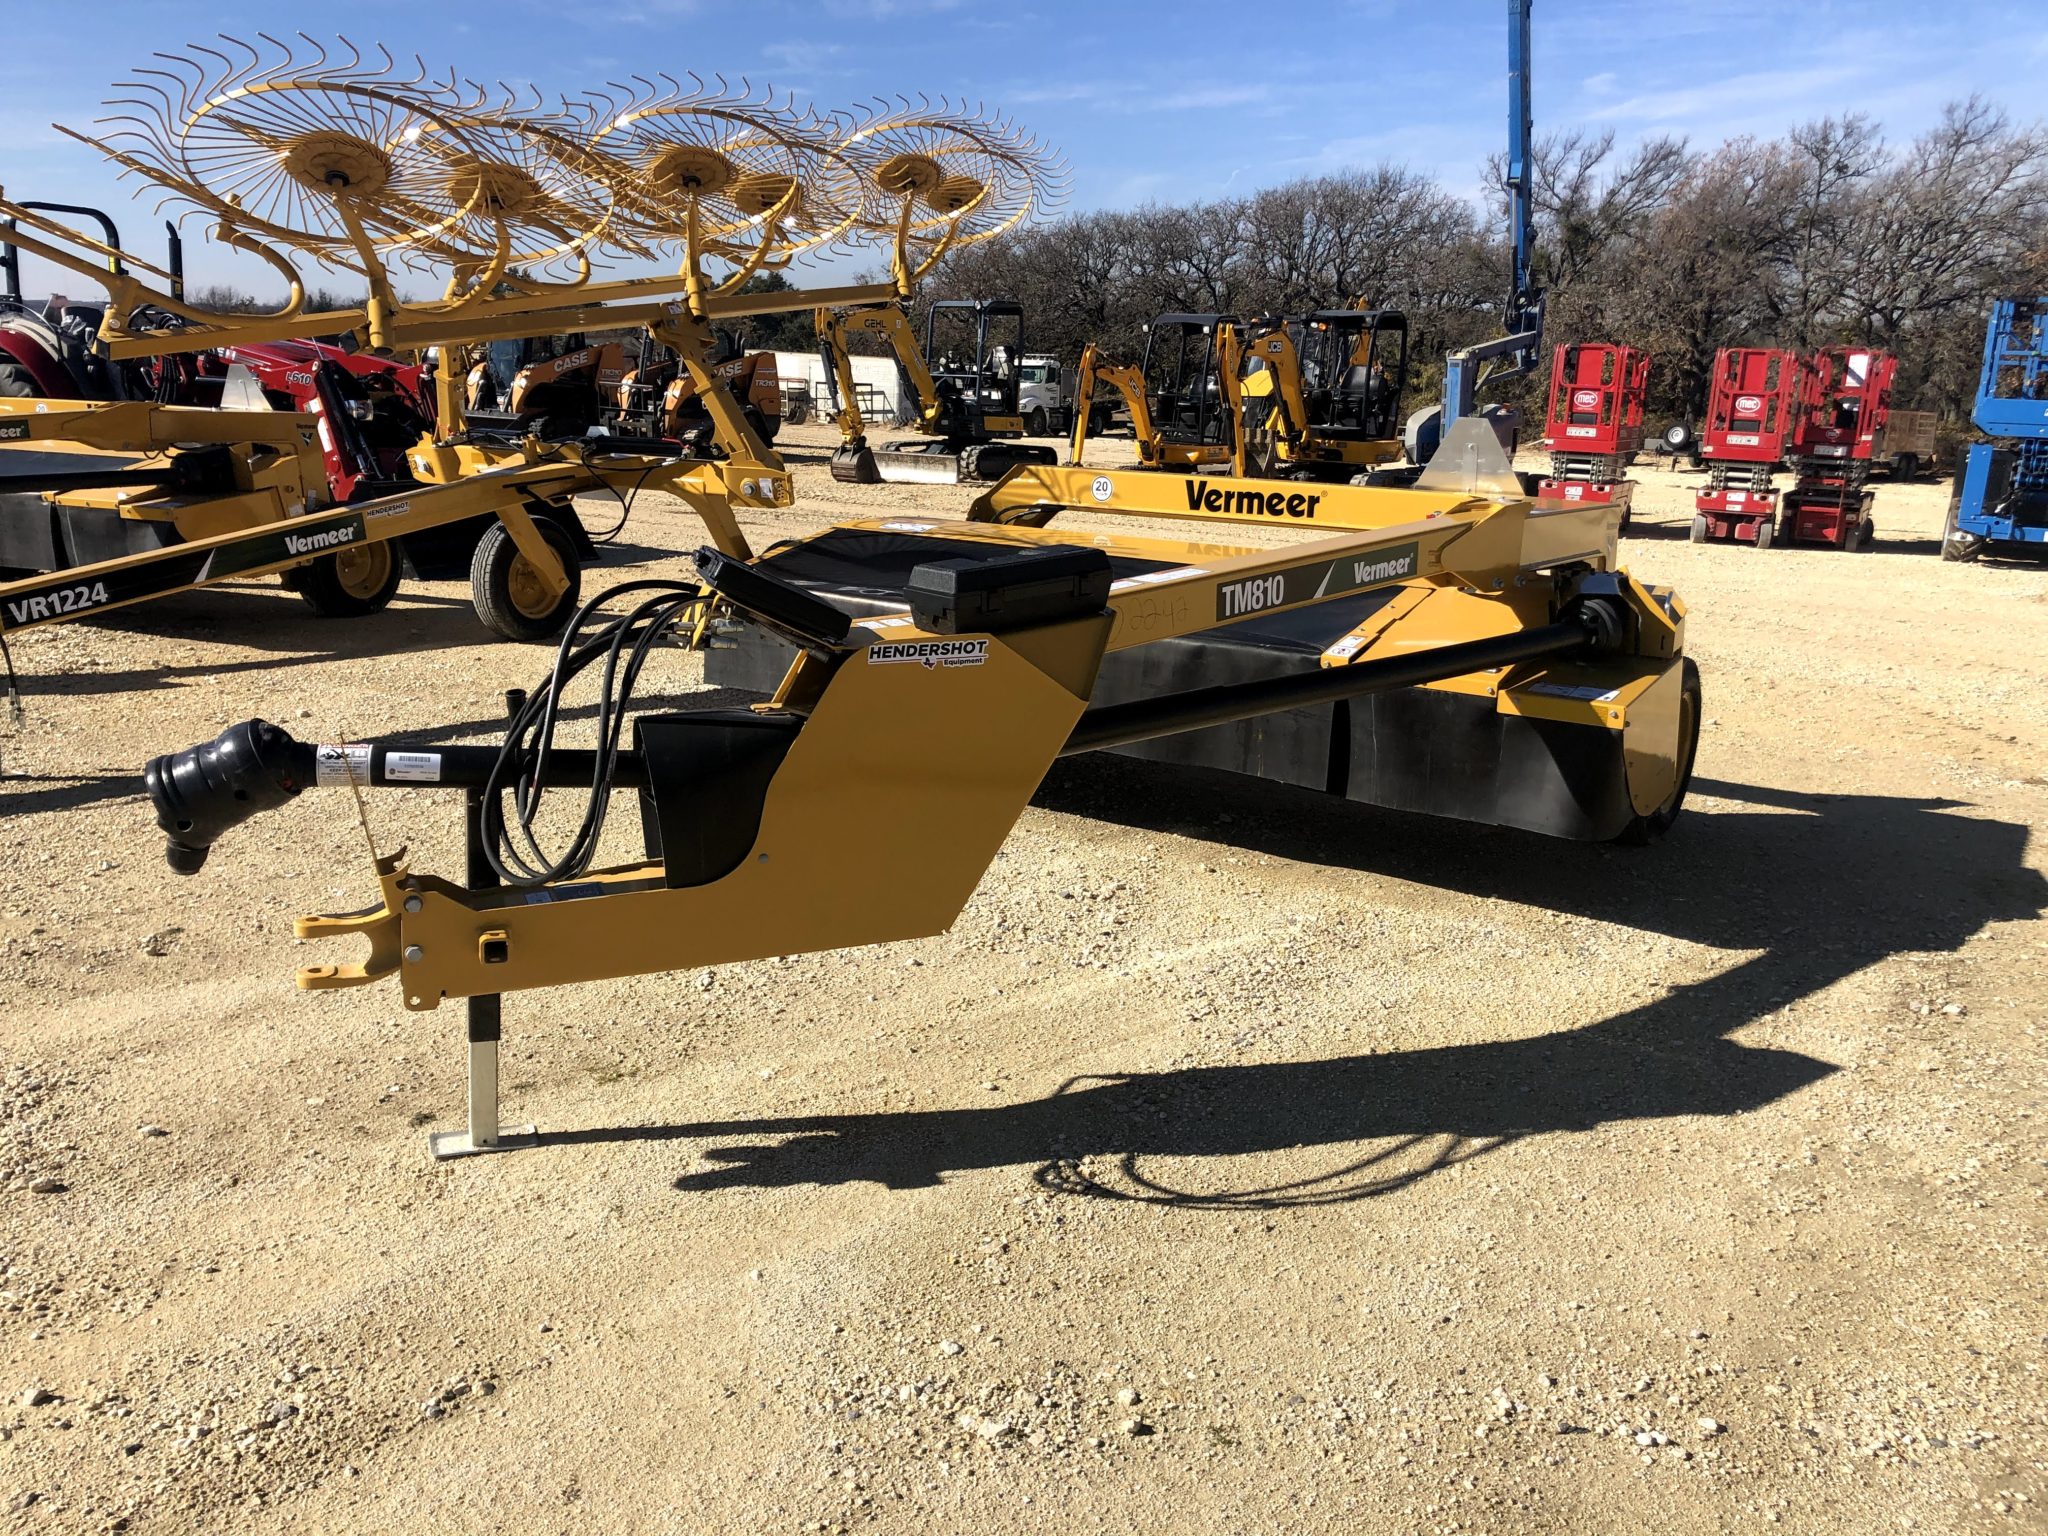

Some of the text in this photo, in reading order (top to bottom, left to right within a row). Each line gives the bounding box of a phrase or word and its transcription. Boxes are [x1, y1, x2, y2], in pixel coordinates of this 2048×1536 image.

[864, 318, 887, 329] GEHL
[1267, 341, 1283, 353] JCB
[554, 351, 588, 373] CASE
[714, 361, 743, 378] ASE
[286, 371, 312, 387] L610
[755, 379, 776, 388] TR310
[1127, 376, 1141, 398] JCB
[1095, 480, 1109, 493] 20
[1185, 479, 1321, 519] Vermeer
[366, 501, 410, 517] HENDERSHOT
[284, 525, 354, 555] Vermeer
[1221, 575, 1285, 617] TM810
[1353, 557, 1411, 584] Vermeer
[7, 582, 109, 623] VR1224
[869, 640, 988, 660] HENDERSHOT
[943, 658, 983, 666] Equipment
